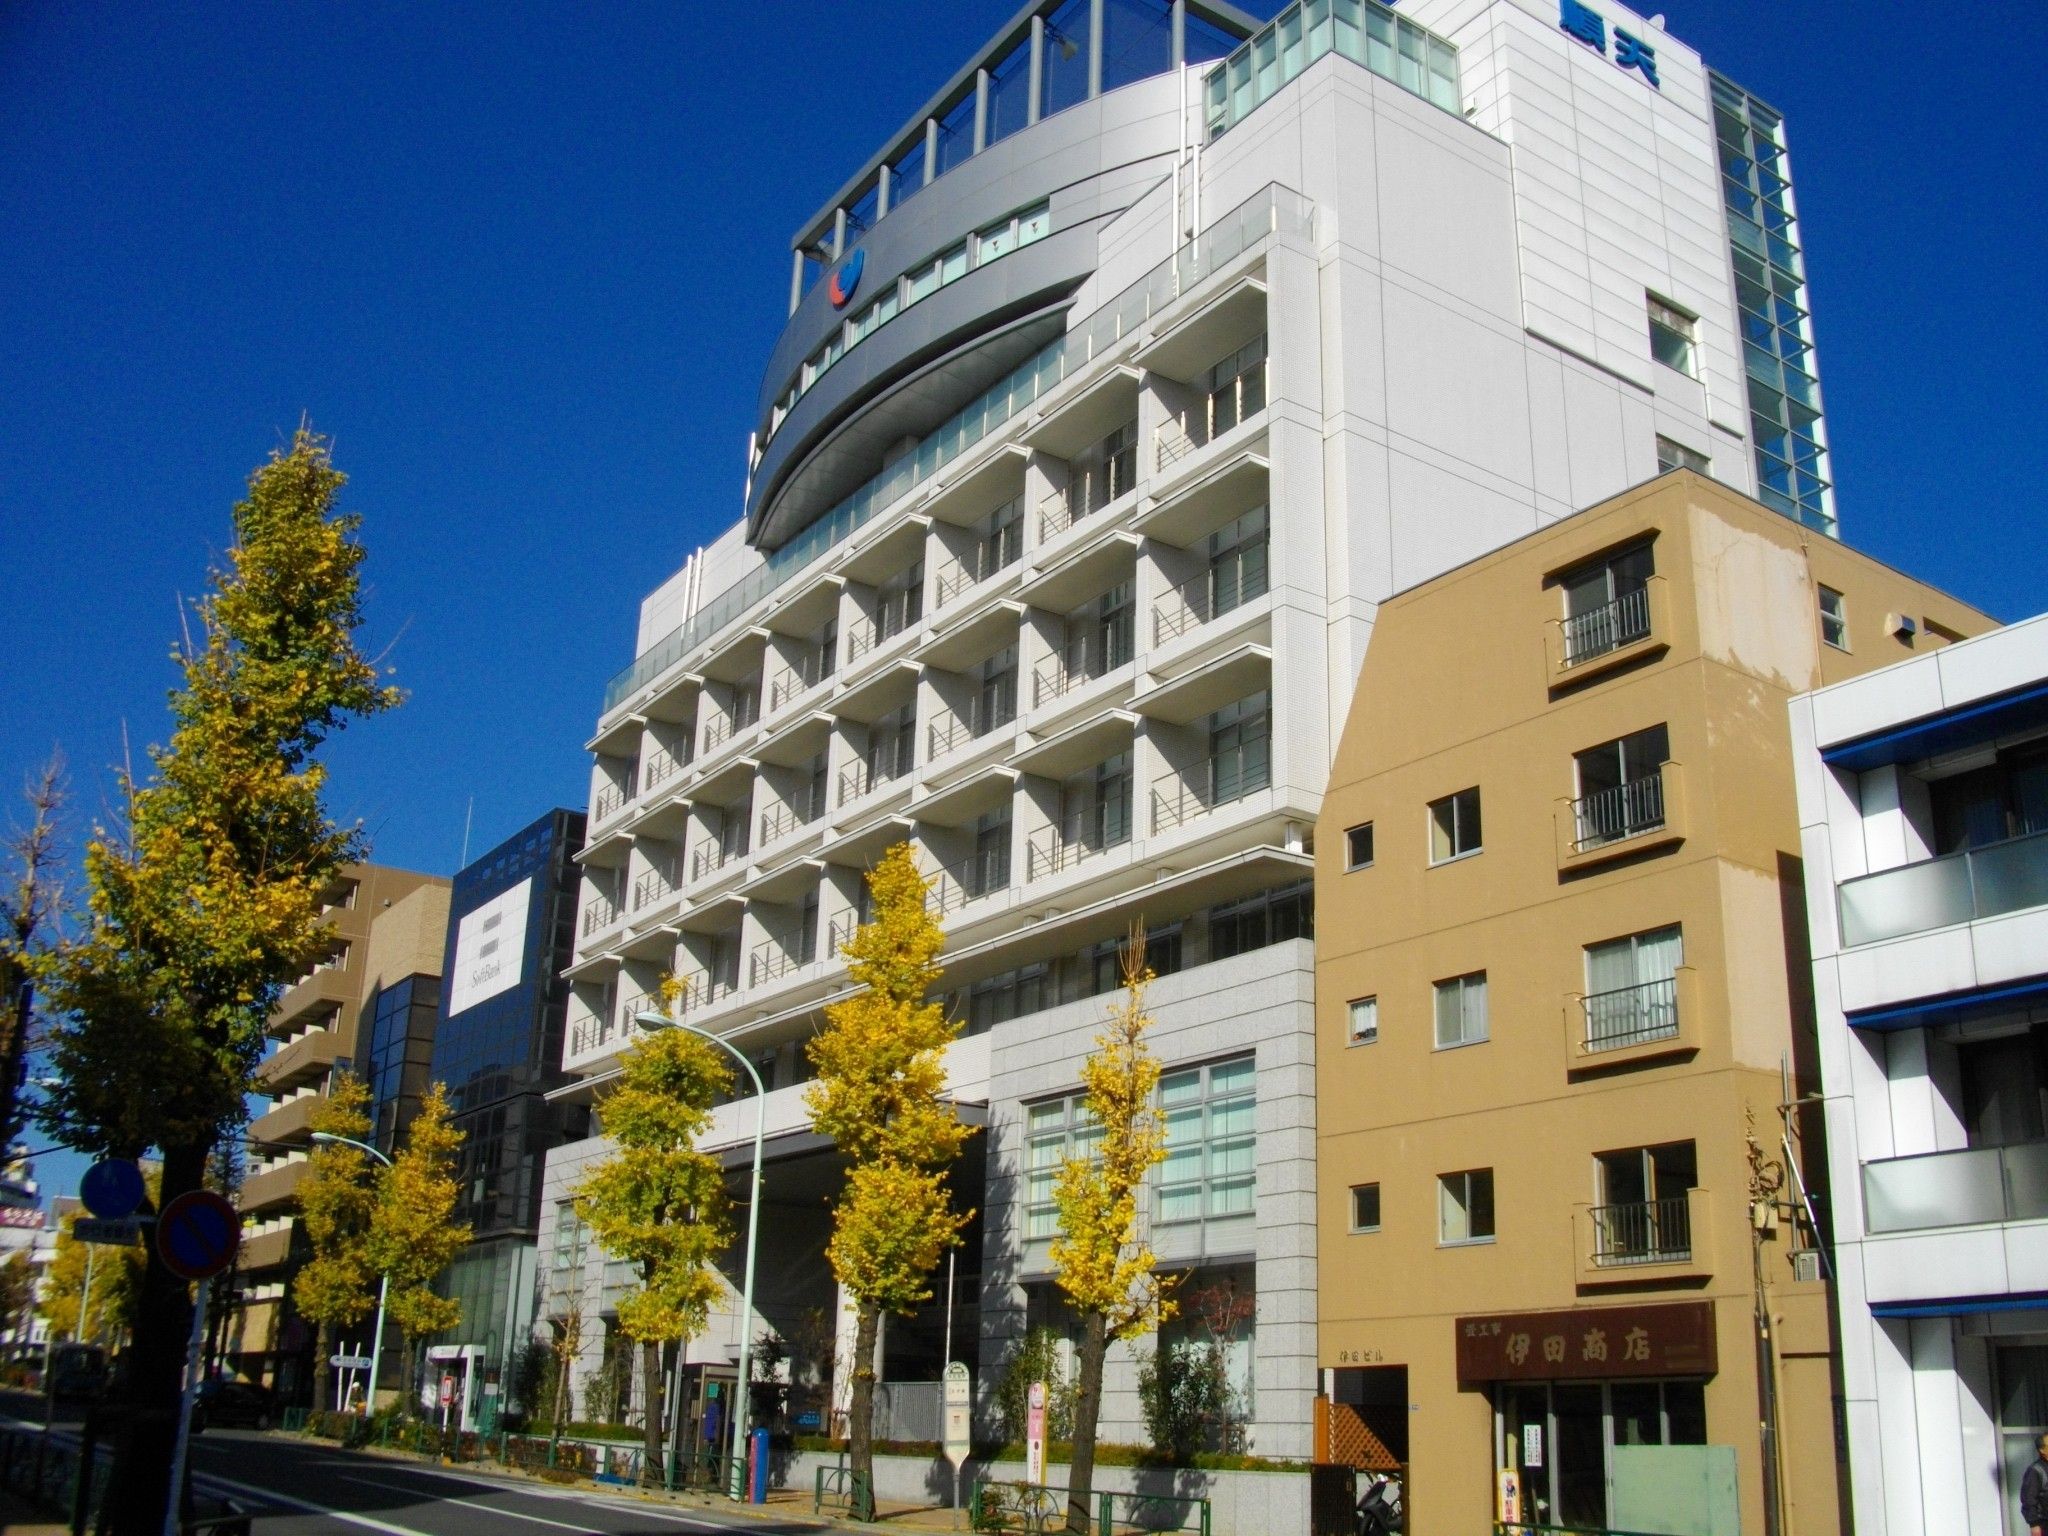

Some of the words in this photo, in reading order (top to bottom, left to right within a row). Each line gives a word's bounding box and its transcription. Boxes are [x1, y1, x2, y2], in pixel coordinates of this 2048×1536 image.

[472, 959, 500, 989] SoftBank
[1505, 1326, 1650, 1366] 伊田商店
